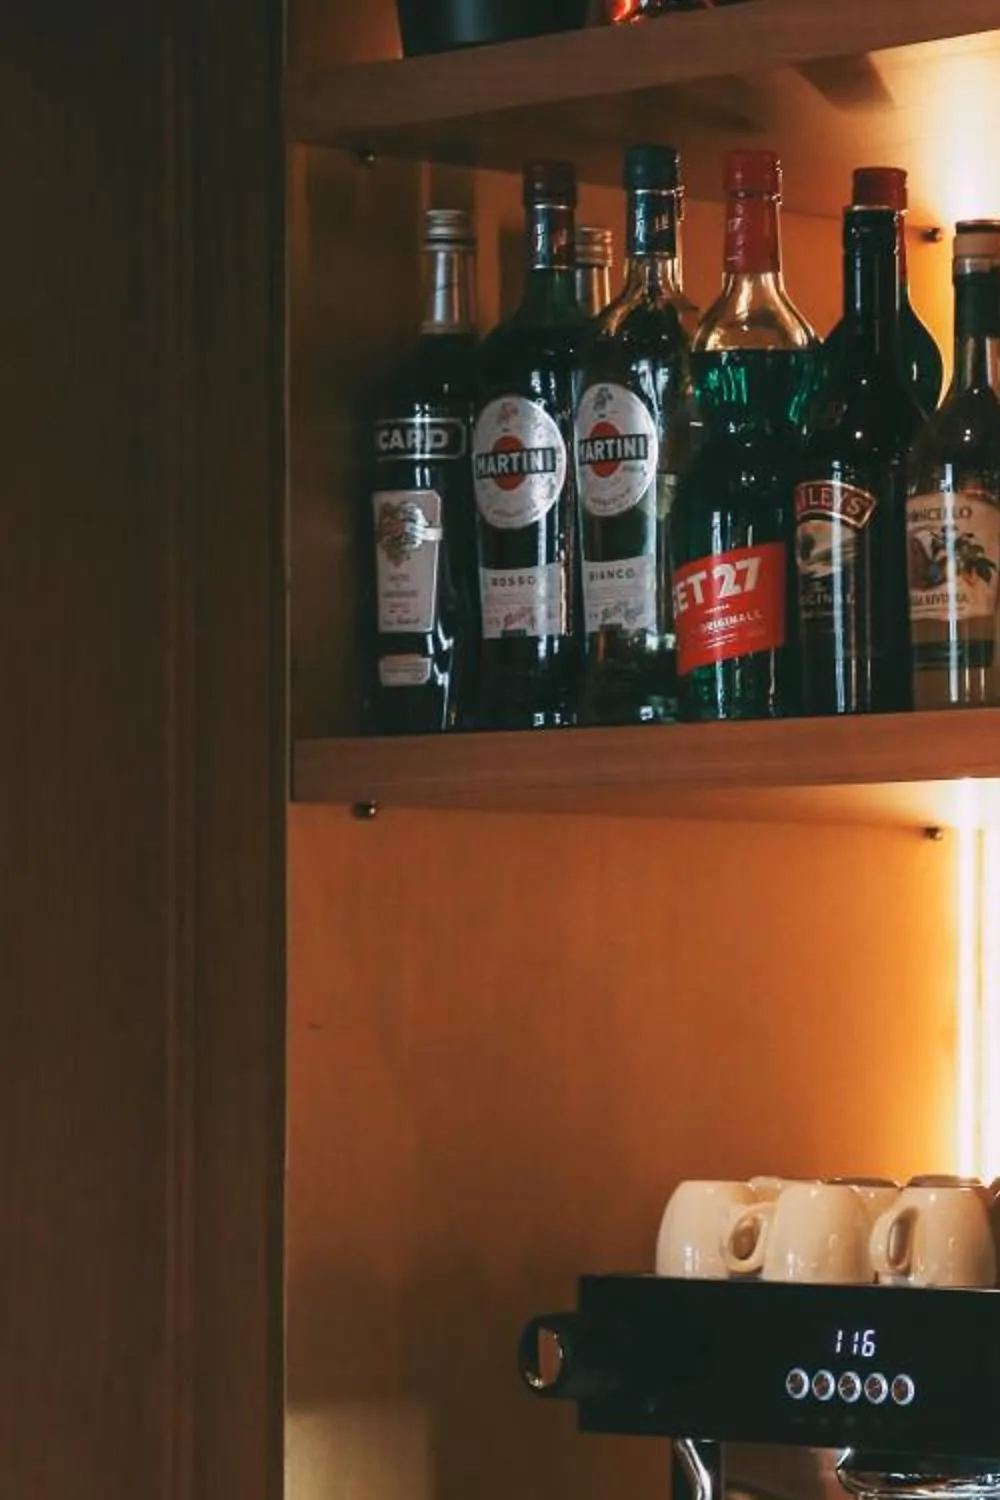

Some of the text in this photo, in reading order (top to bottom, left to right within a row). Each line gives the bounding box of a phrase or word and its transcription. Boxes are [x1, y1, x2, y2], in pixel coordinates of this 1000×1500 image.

[477, 449, 555, 475] MARTINI
[490, 575, 537, 587] ROSSO
[588, 567, 635, 582] BIANCO
[672, 569, 708, 620] ET
[712, 556, 763, 598] 27
[835, 1328, 876, 1357] 116
